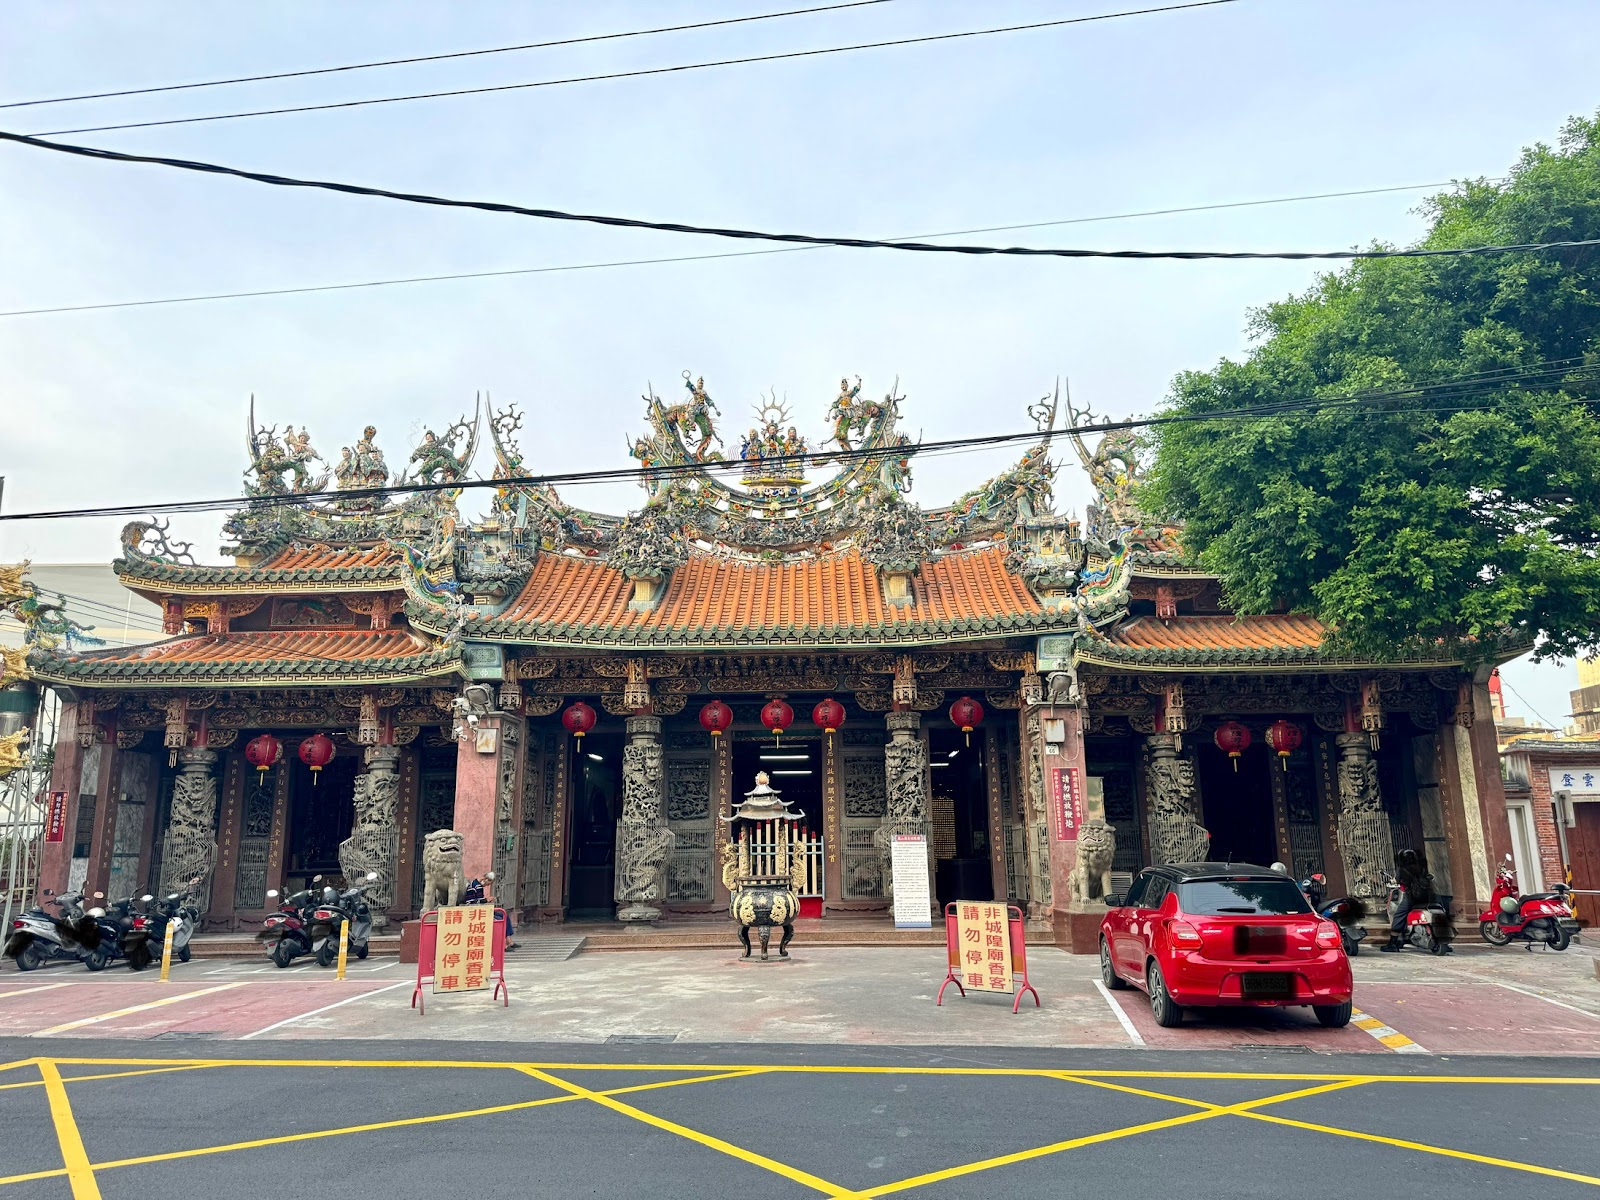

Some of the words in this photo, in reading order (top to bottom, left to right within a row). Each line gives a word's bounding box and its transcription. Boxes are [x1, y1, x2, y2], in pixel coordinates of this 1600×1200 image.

[1061, 774, 1074, 829] 請勿燃放鞭炮
[1560, 772, 1595, 788] 登雲
[440, 909, 463, 990] 請勿停車
[465, 908, 487, 988] 非城隍廟香客
[962, 905, 985, 988] 請勿停車
[984, 906, 1007, 990] 非城隍廟香客
